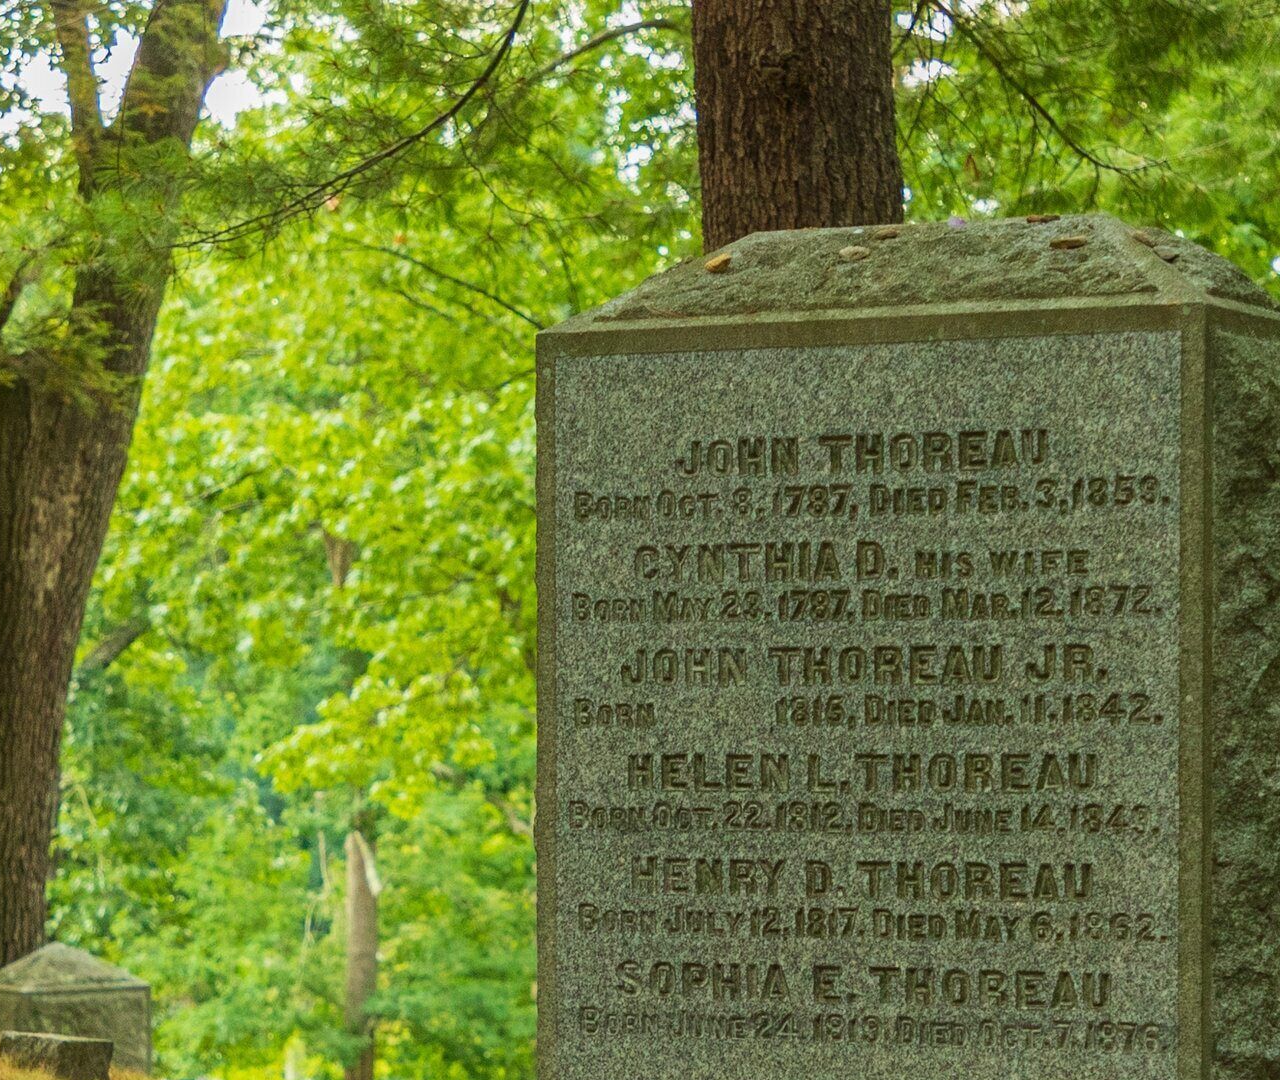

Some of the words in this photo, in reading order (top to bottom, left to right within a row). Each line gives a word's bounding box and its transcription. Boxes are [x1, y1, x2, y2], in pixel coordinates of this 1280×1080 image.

[675, 434, 799, 478] JOHN
[819, 429, 1048, 475] THOREAU
[635, 542, 840, 582] CYNTHIA
[856, 540, 899, 581] D.
[915, 552, 973, 578] HIS
[989, 551, 1089, 576] WIFE
[621, 648, 746, 687] JOHN
[770, 645, 1003, 687] THOREAU
[1026, 644, 1109, 684] JR.
[628, 754, 789, 793] HELEN
[854, 753, 1097, 793] THOREAU
[630, 857, 784, 897] HENRY
[805, 860, 845, 899] D.
[856, 861, 1093, 900] THOREAU
[616, 960, 792, 1000] SOPHIA
[812, 963, 863, 1001] E.
[869, 966, 1112, 1008] THOREAU
